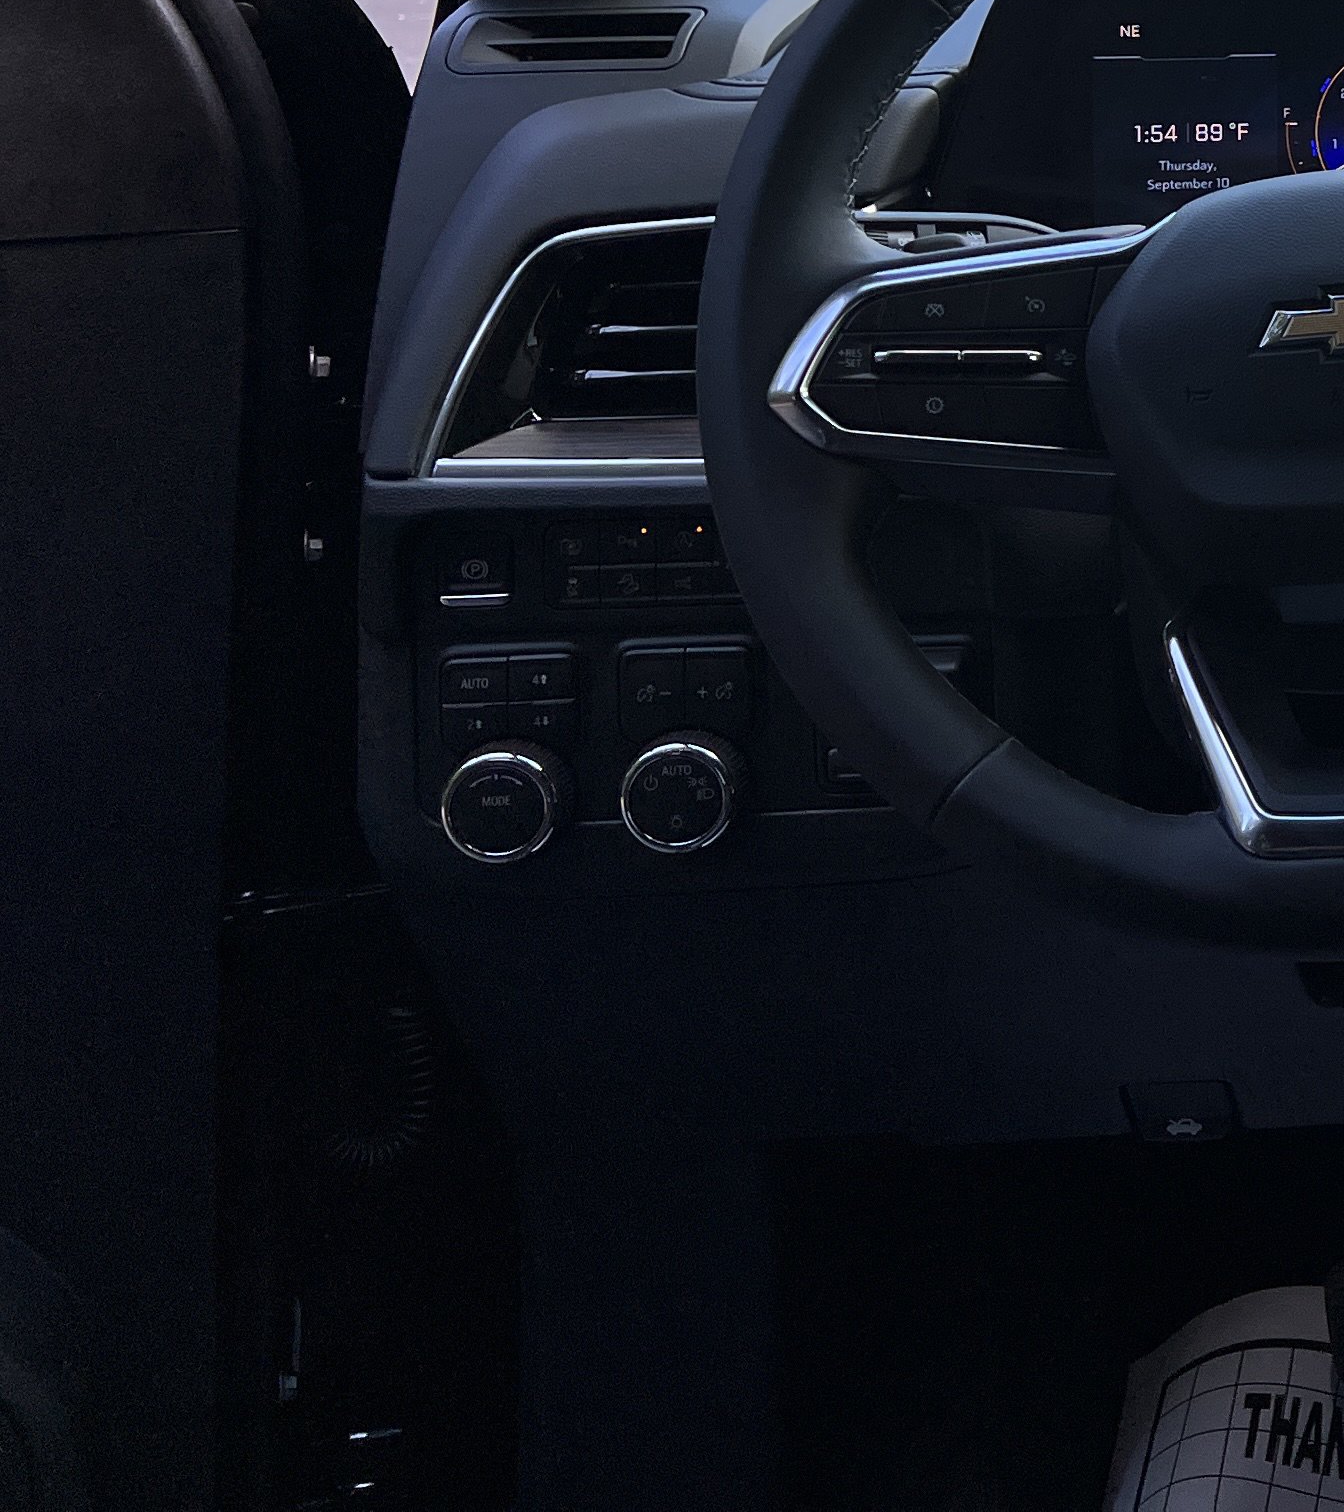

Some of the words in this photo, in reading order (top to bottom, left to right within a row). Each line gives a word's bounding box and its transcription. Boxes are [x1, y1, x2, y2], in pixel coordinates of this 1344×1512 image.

[1119, 25, 1141, 38] NE
[1283, 107, 1291, 119] F
[1134, 124, 1178, 144] 1:54
[1195, 123, 1224, 142] 89
[1159, 159, 1218, 174] Thursday,
[1147, 178, 1214, 192] September
[460, 678, 490, 689] AUTO
[661, 763, 692, 777] AUTO
[481, 794, 512, 809] MODE
